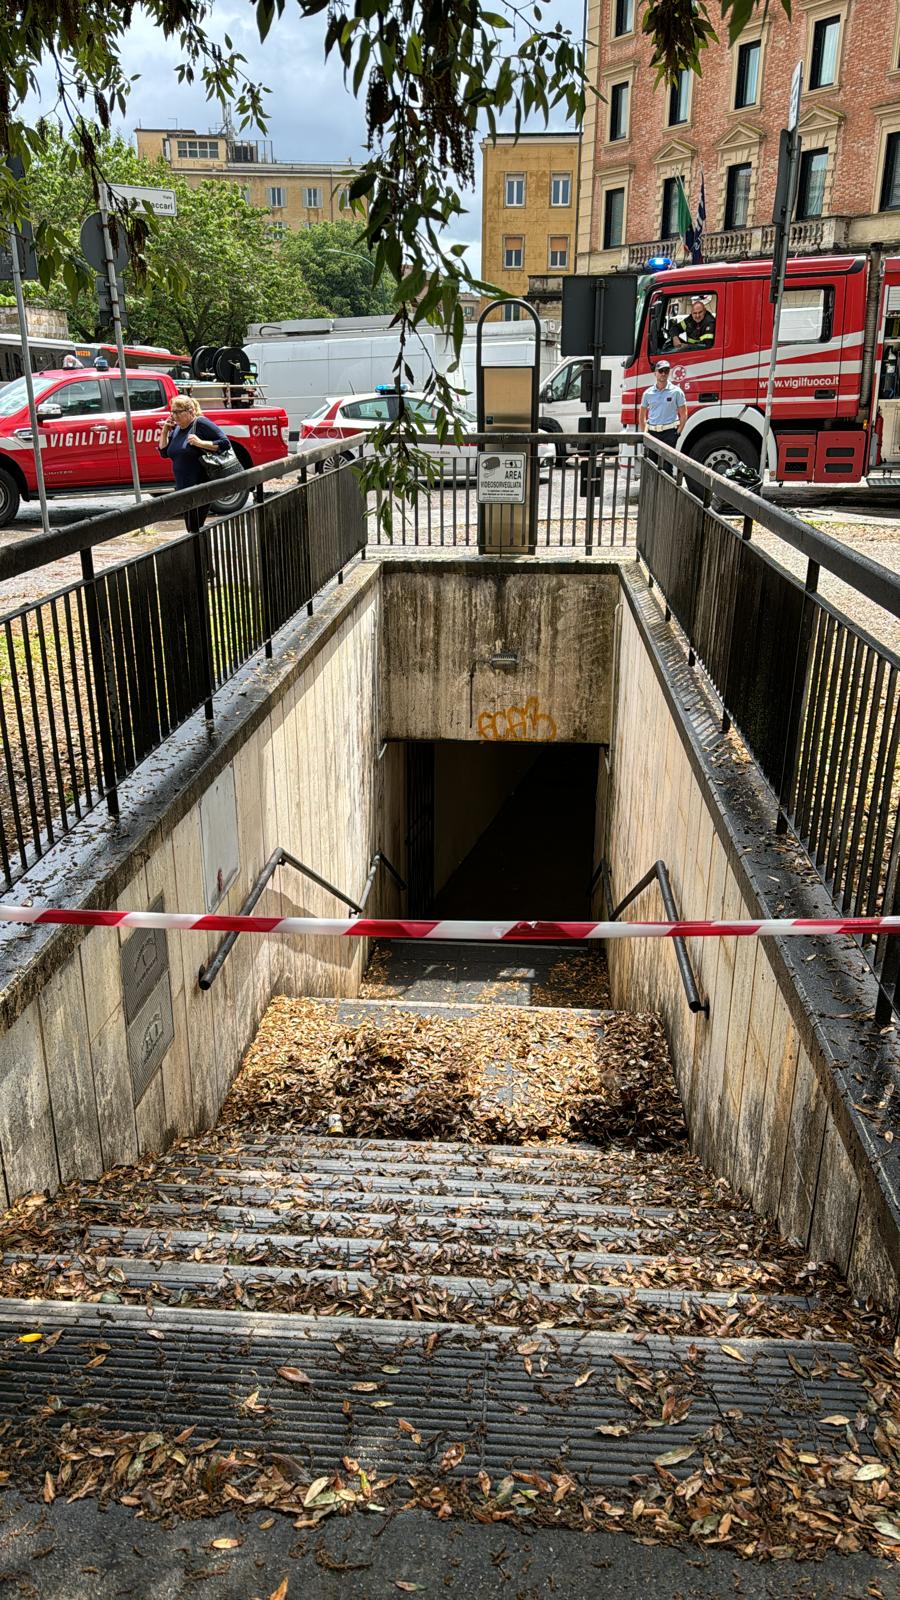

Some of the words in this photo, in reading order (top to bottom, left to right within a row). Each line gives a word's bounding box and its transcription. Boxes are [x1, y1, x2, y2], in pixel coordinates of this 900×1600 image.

[150, 202, 173, 210] accari
[262, 424, 278, 437] 115
[50, 431, 94, 448] VIGILI
[98, 430, 122, 445] DEL
[504, 470, 522, 480] AREA
[480, 480, 522, 488] VIDEOSORVEGLIATA
